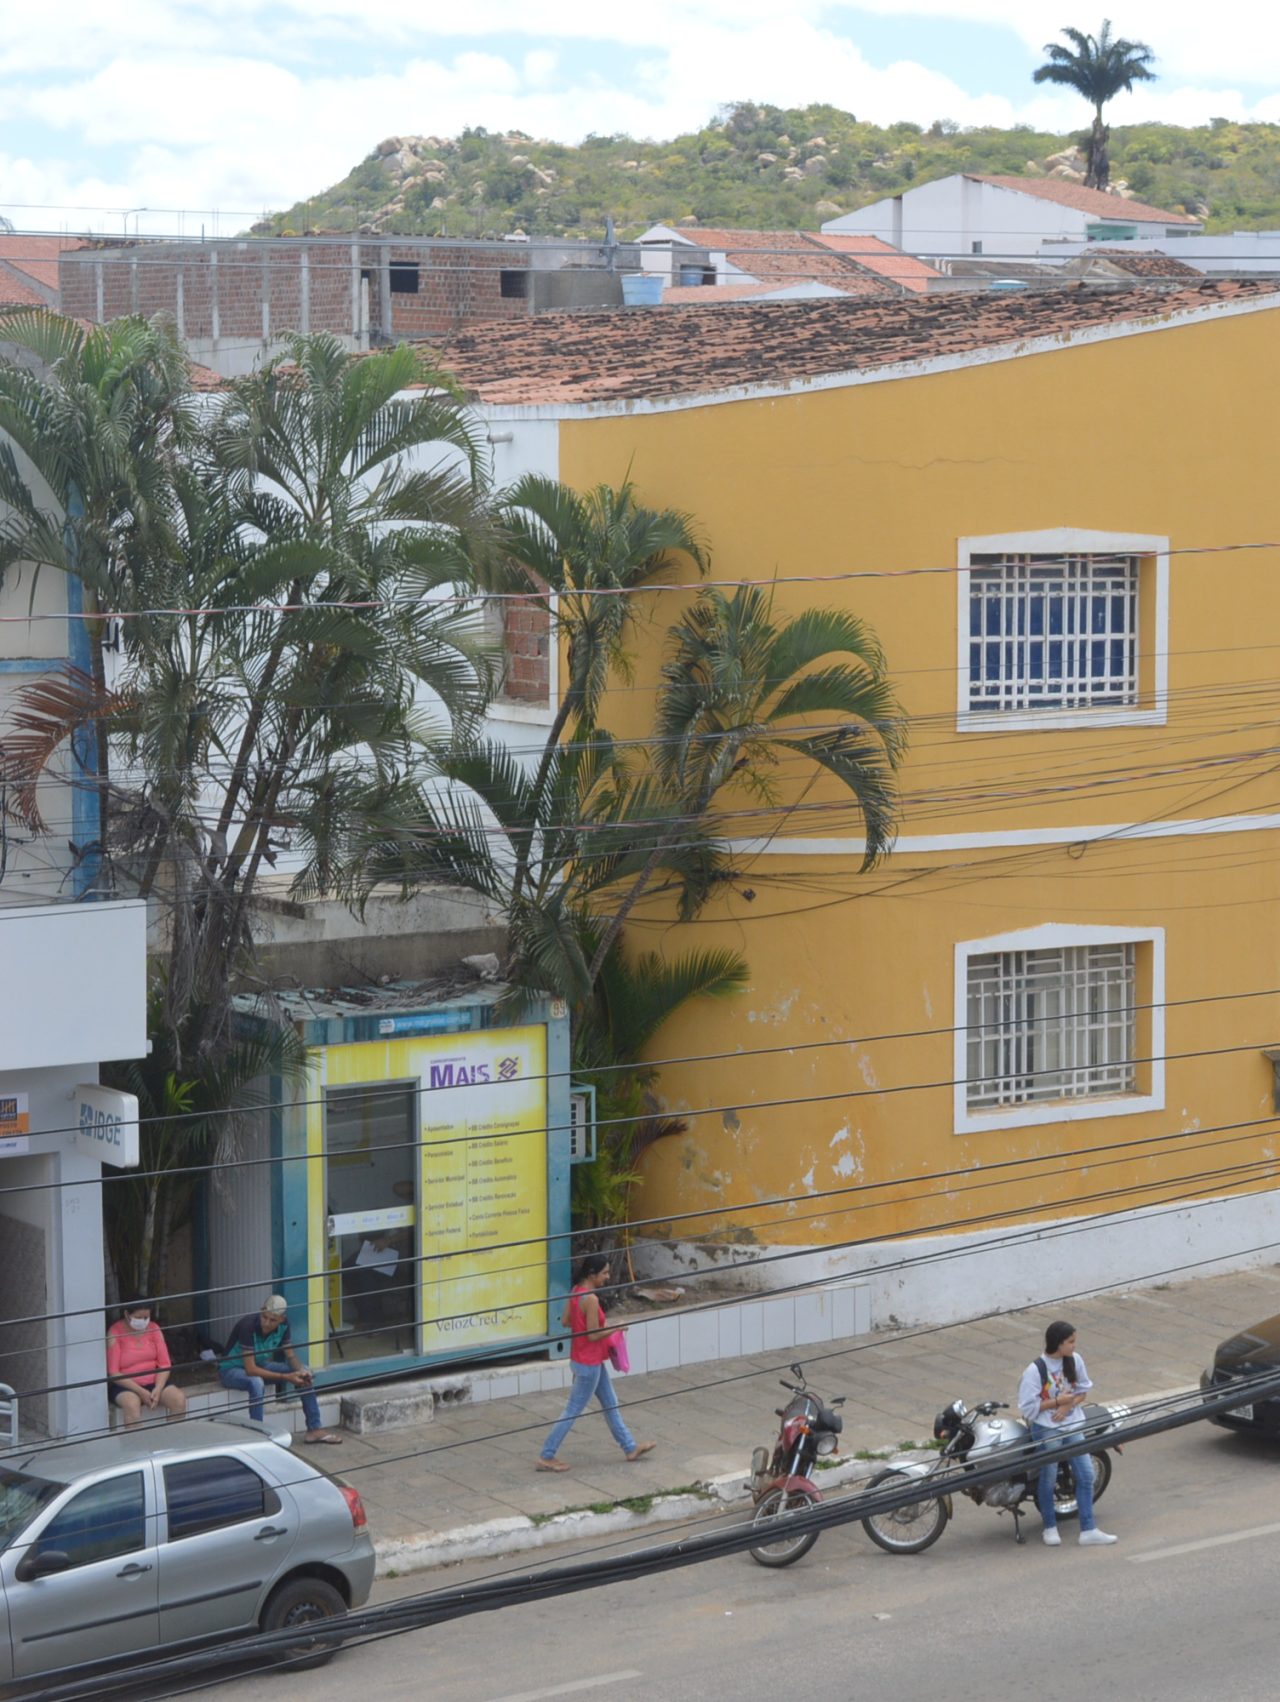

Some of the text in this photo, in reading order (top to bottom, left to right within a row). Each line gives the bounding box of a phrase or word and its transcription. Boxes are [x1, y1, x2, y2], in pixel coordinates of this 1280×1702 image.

[430, 1064, 490, 1088] MAIS
[93, 1109, 122, 1145] IBGE
[436, 1311, 498, 1331] VelozCred
